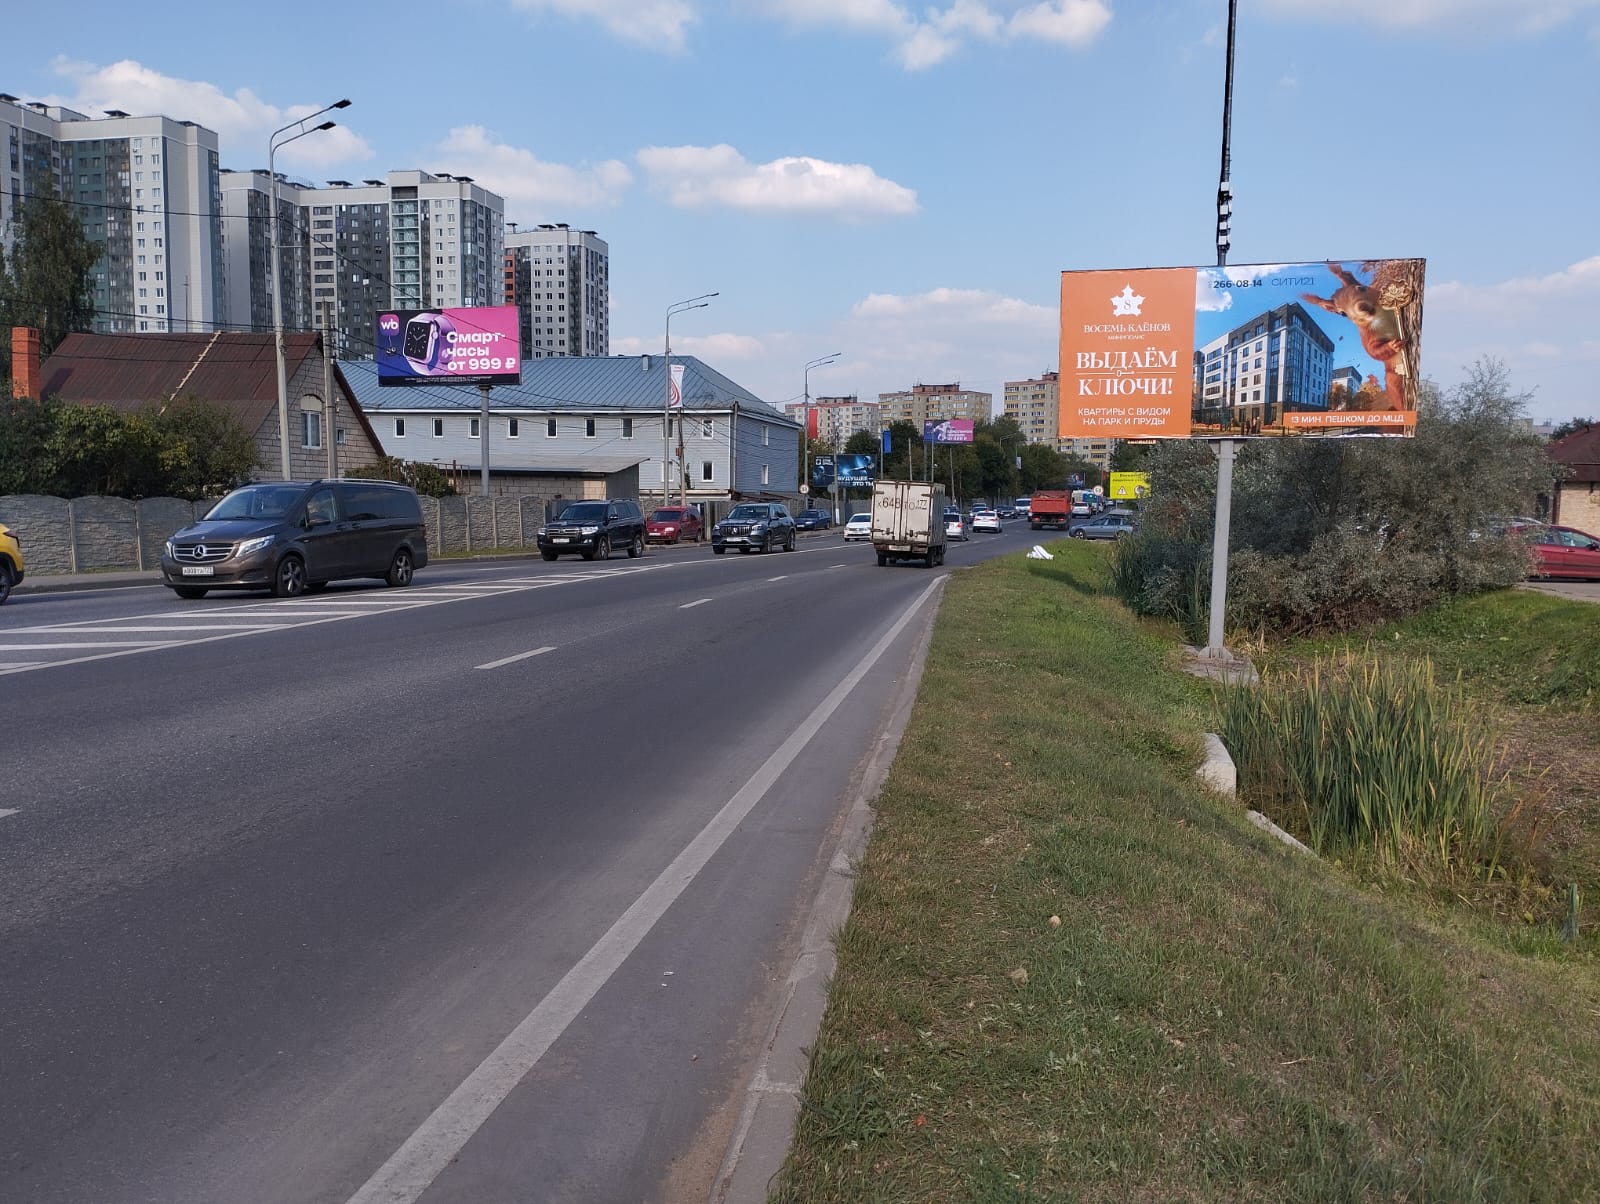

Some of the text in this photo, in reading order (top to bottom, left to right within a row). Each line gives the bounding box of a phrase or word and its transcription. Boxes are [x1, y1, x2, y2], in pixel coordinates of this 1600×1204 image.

[1271, 277, 1314, 286] СИТИ21
[1123, 299, 1132, 310] 8
[381, 318, 399, 330] wb
[1084, 322, 1171, 333] ВОСЕМЬ КЛЁНОВ
[446, 332, 505, 344] Смарт-
[446, 346, 489, 357] часы
[447, 360, 466, 371] от
[469, 358, 501, 369] 999
[1076, 347, 1178, 371] ВЫДАЁМ
[1078, 378, 1173, 396] КЛЮЧИ!
[1078, 407, 1171, 416] КВАРТИРЫ С ВИДОМ
[1133, 417, 1166, 426] ПРУДЫ
[1325, 415, 1364, 423] ПЕШКОМ
[1366, 414, 1380, 423] ДО
[1382, 414, 1404, 423] МЦД
